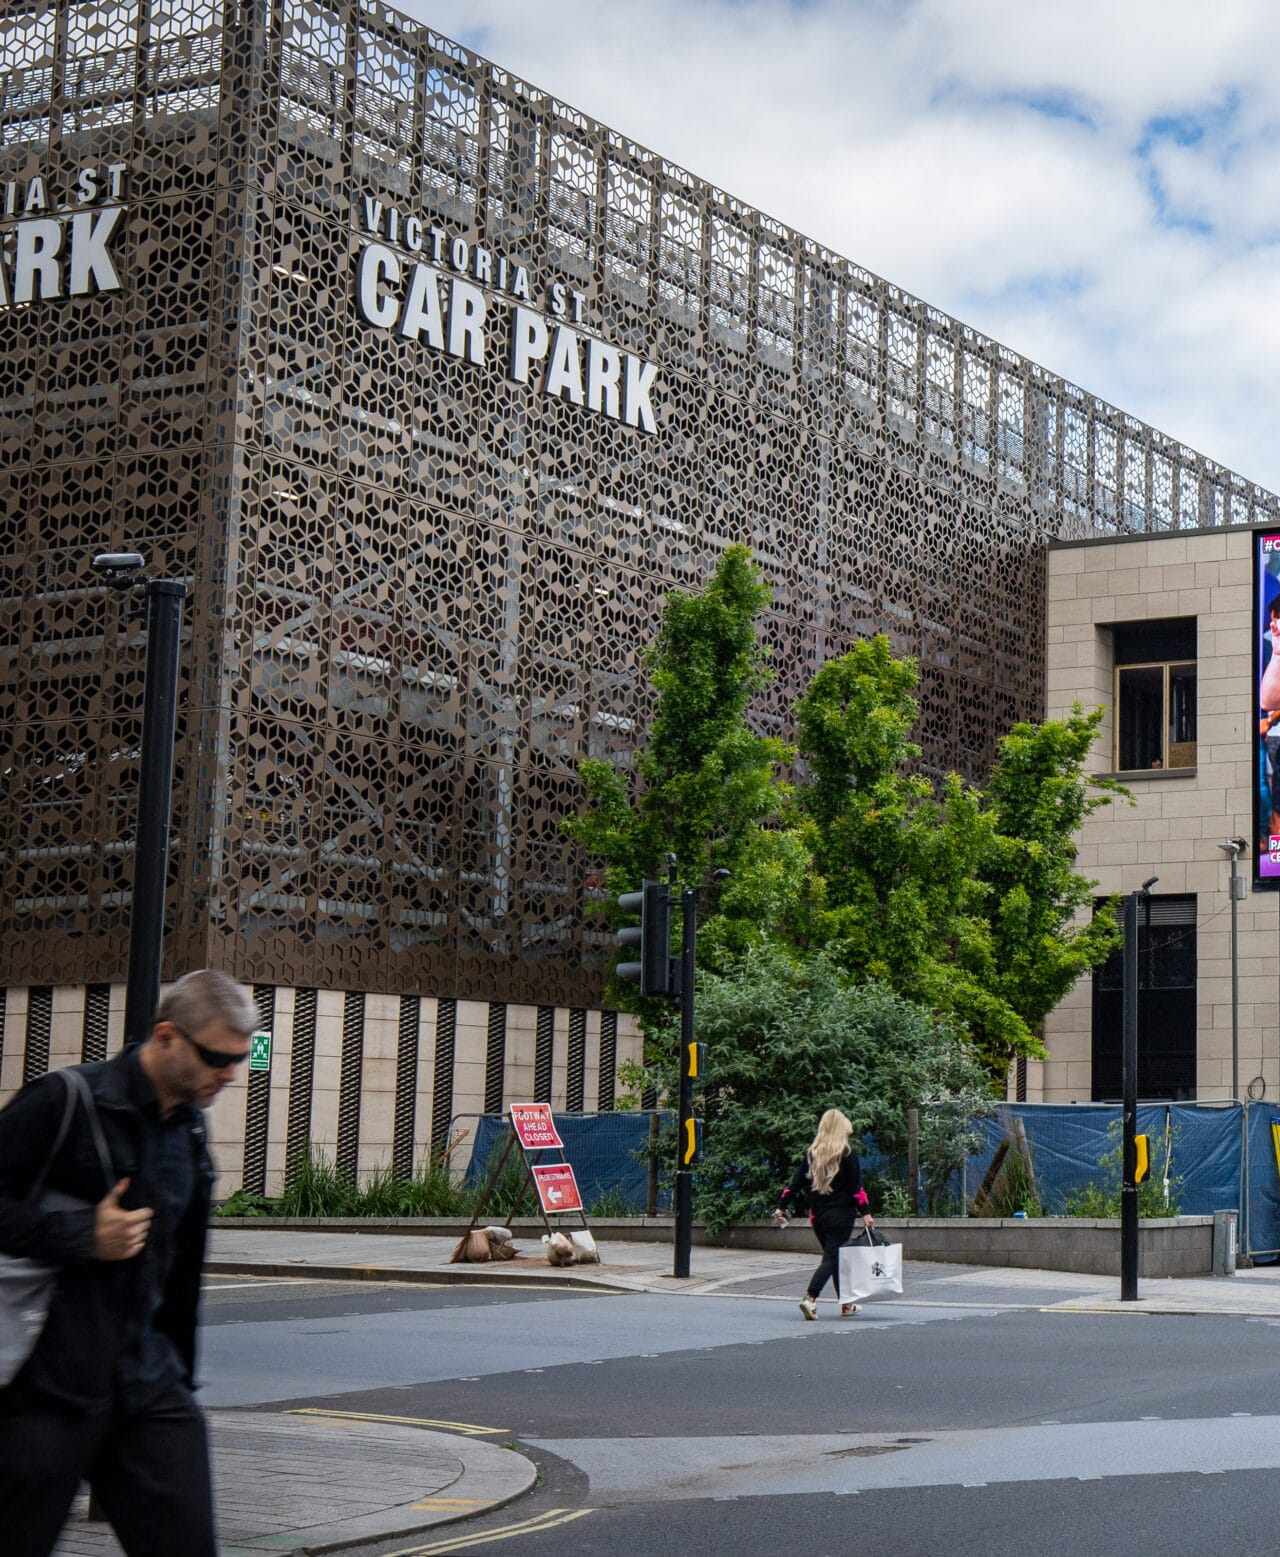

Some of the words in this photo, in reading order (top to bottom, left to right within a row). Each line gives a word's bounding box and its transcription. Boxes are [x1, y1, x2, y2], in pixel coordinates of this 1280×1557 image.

[78, 162, 128, 202] ST
[364, 195, 530, 300] VICTORIA
[551, 283, 586, 323] ST
[360, 244, 486, 367] CAR
[512, 305, 660, 436] PARK
[513, 1111, 550, 1120] FOOTWAY
[523, 1122, 547, 1131] AHEAD
[524, 1133, 554, 1141] CLOSED
